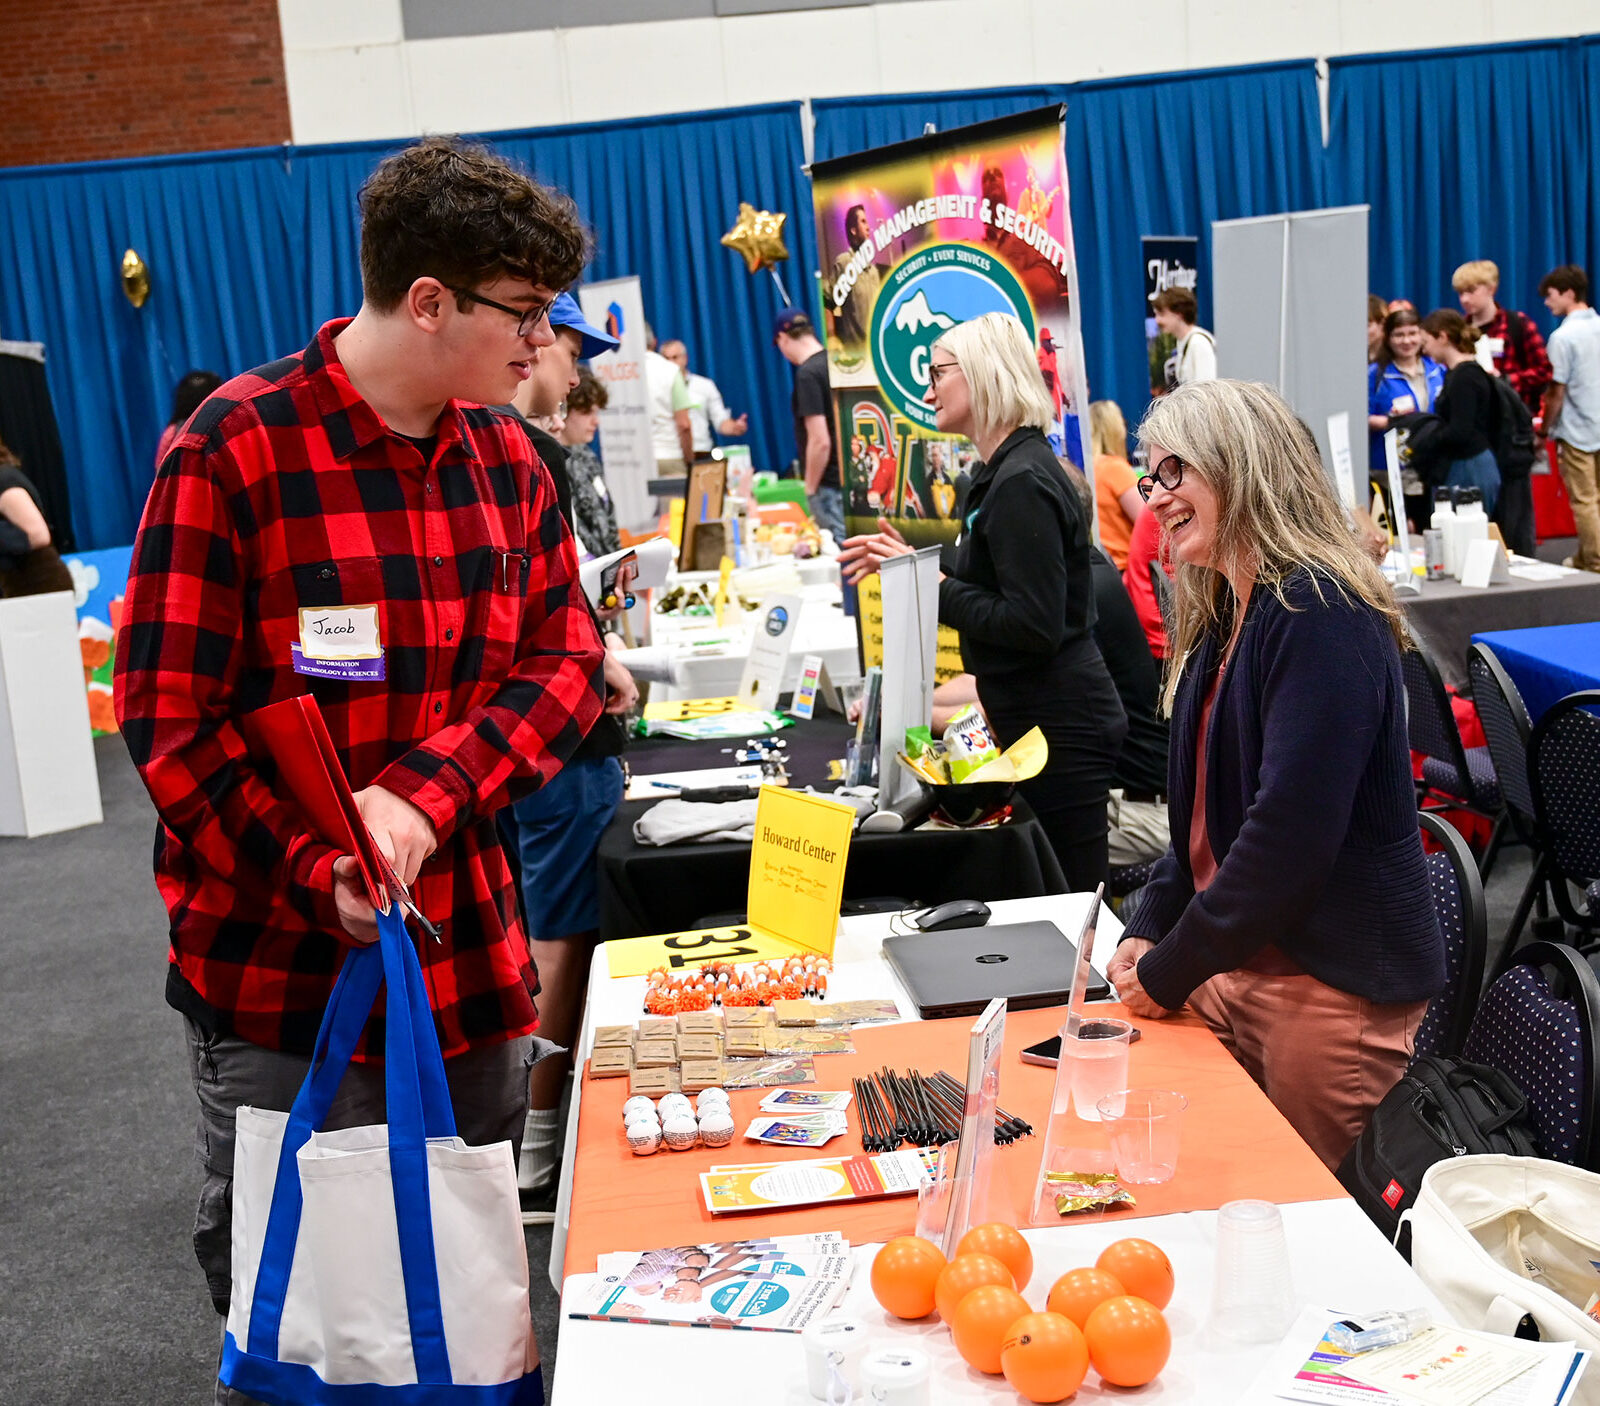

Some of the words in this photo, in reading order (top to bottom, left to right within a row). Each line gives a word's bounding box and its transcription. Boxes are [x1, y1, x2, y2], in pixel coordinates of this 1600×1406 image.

[832, 239, 876, 307] CROWD
[873, 195, 977, 252] MANAGEMENT
[979, 198, 993, 225] &
[894, 255, 927, 285] SECURITY
[932, 249, 956, 263] EVENT
[956, 249, 991, 272] SERVICES
[312, 617, 355, 635] Jacob
[300, 665, 342, 676] TECHNOLOGY
[762, 827, 801, 853] Howard
[803, 839, 837, 863] Center
[664, 929, 758, 968] 31
